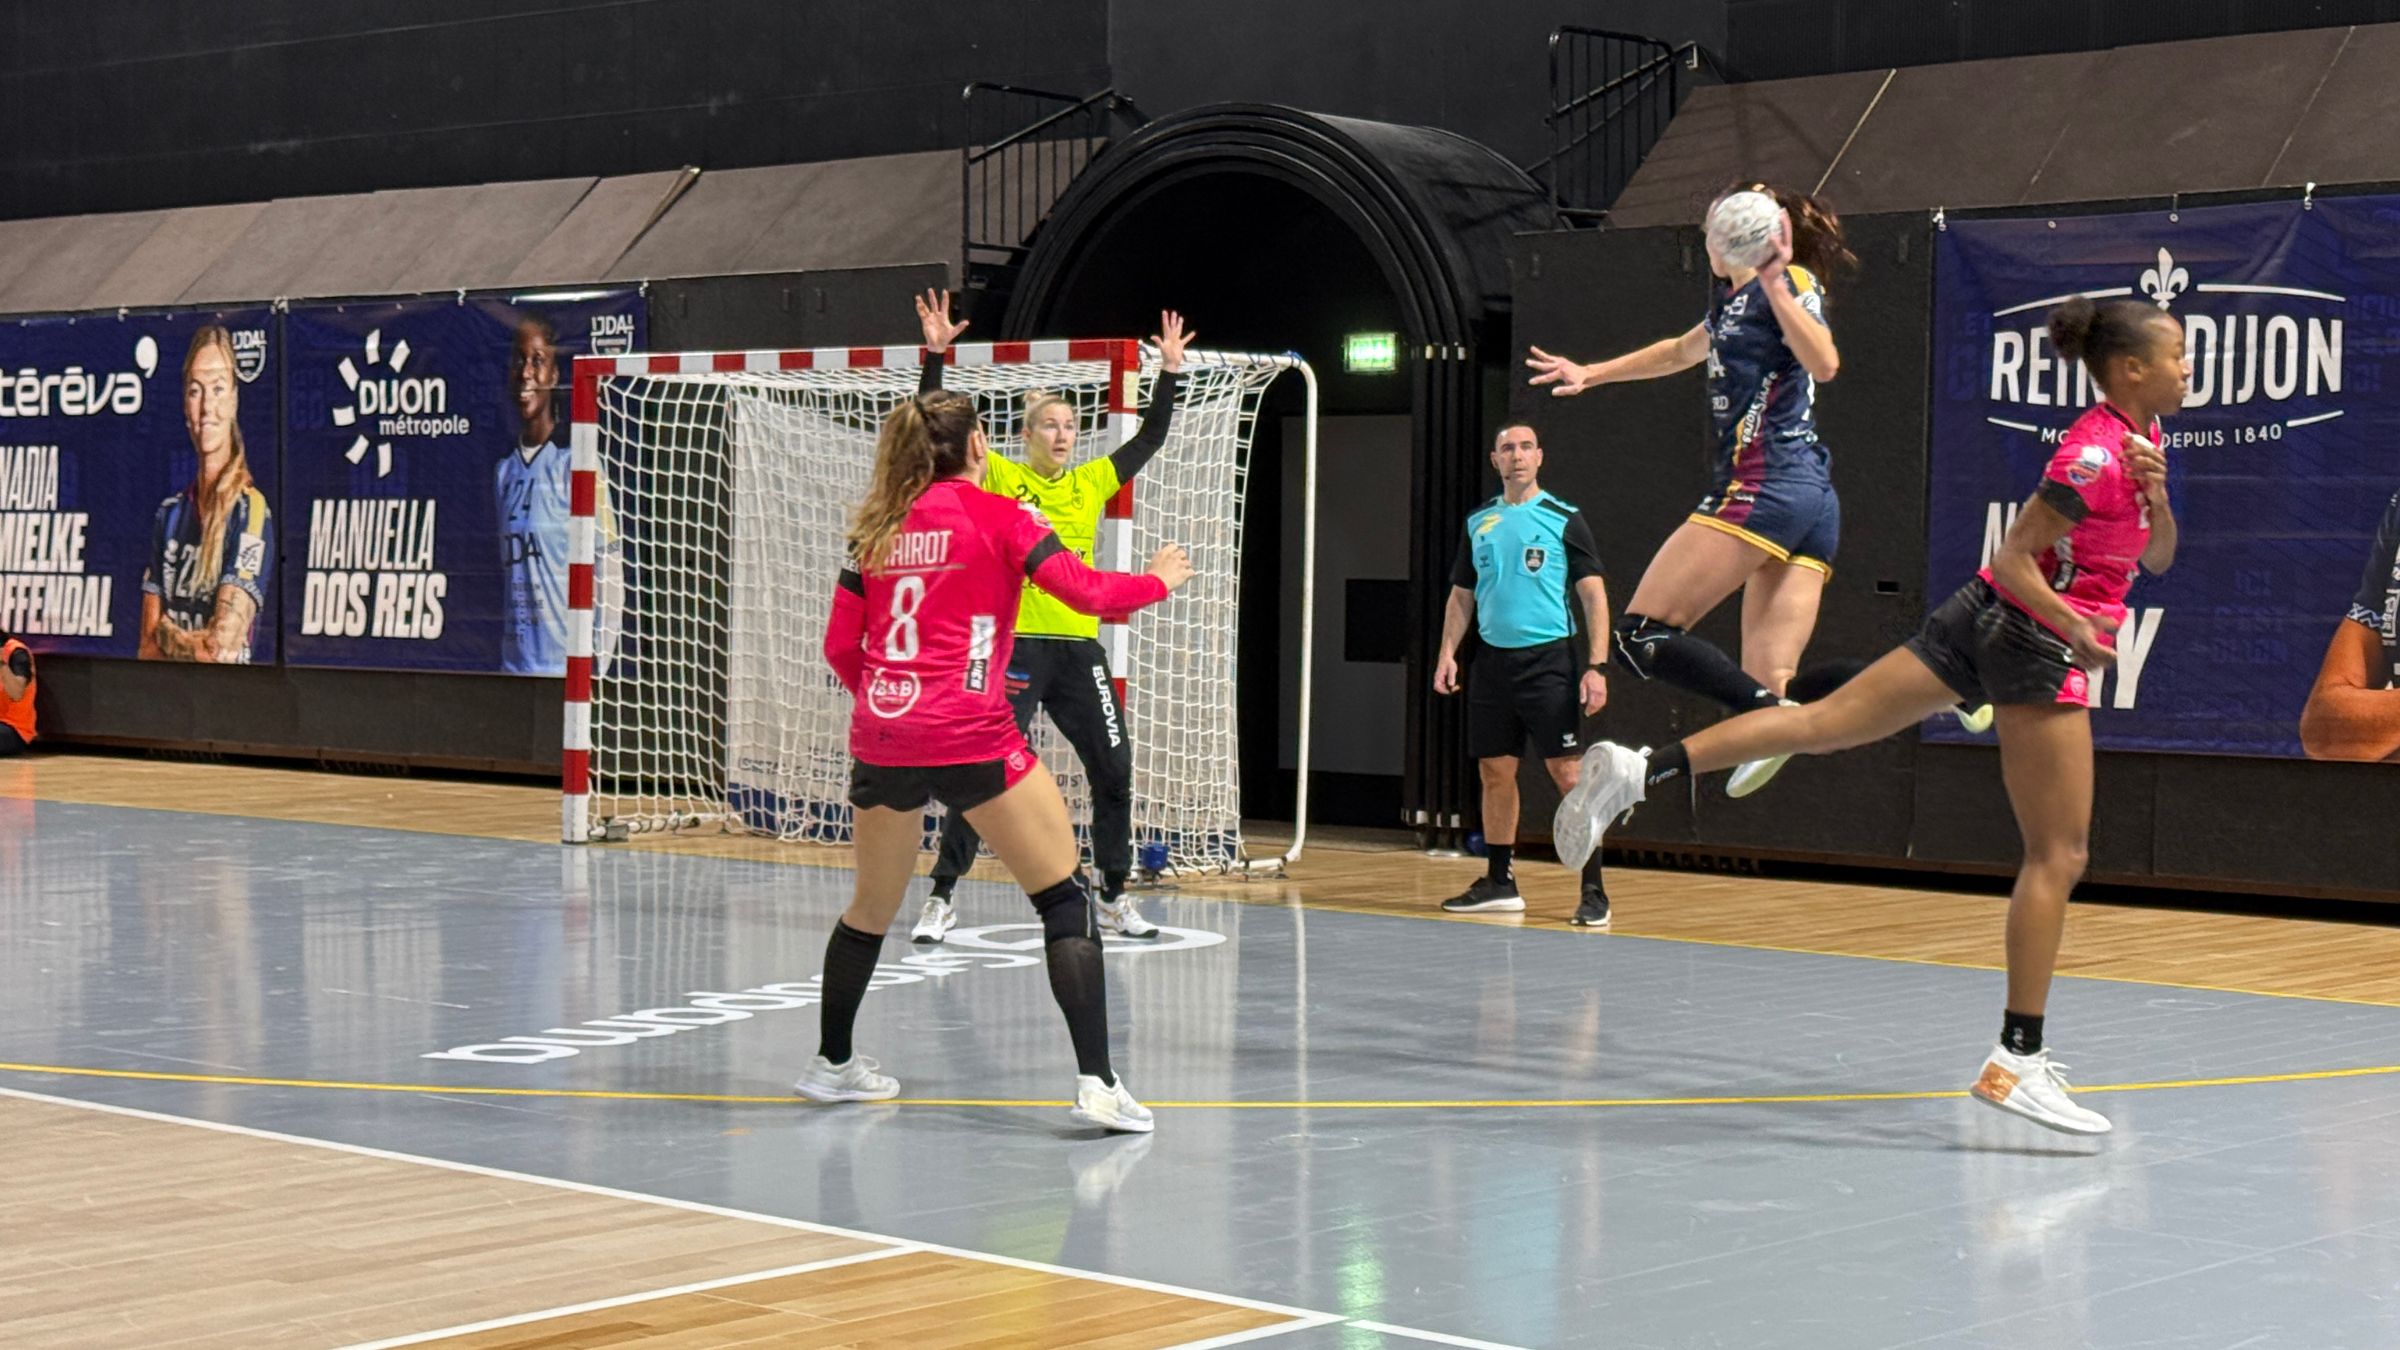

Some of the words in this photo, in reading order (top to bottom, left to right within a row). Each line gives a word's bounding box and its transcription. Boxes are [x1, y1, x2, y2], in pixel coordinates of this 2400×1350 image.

[2181, 314, 2343, 408] DIJON
[379, 414, 470, 438] métropole
[2161, 430, 2225, 448] DEPUIS
[2234, 423, 2282, 444] 1840
[308, 499, 436, 571] MANUELLA
[0, 573, 113, 637] FFENDAL
[302, 571, 371, 637] DOS
[371, 572, 448, 640] REIS
[885, 576, 926, 662] 8
[1092, 664, 1121, 748] EUROVIA
